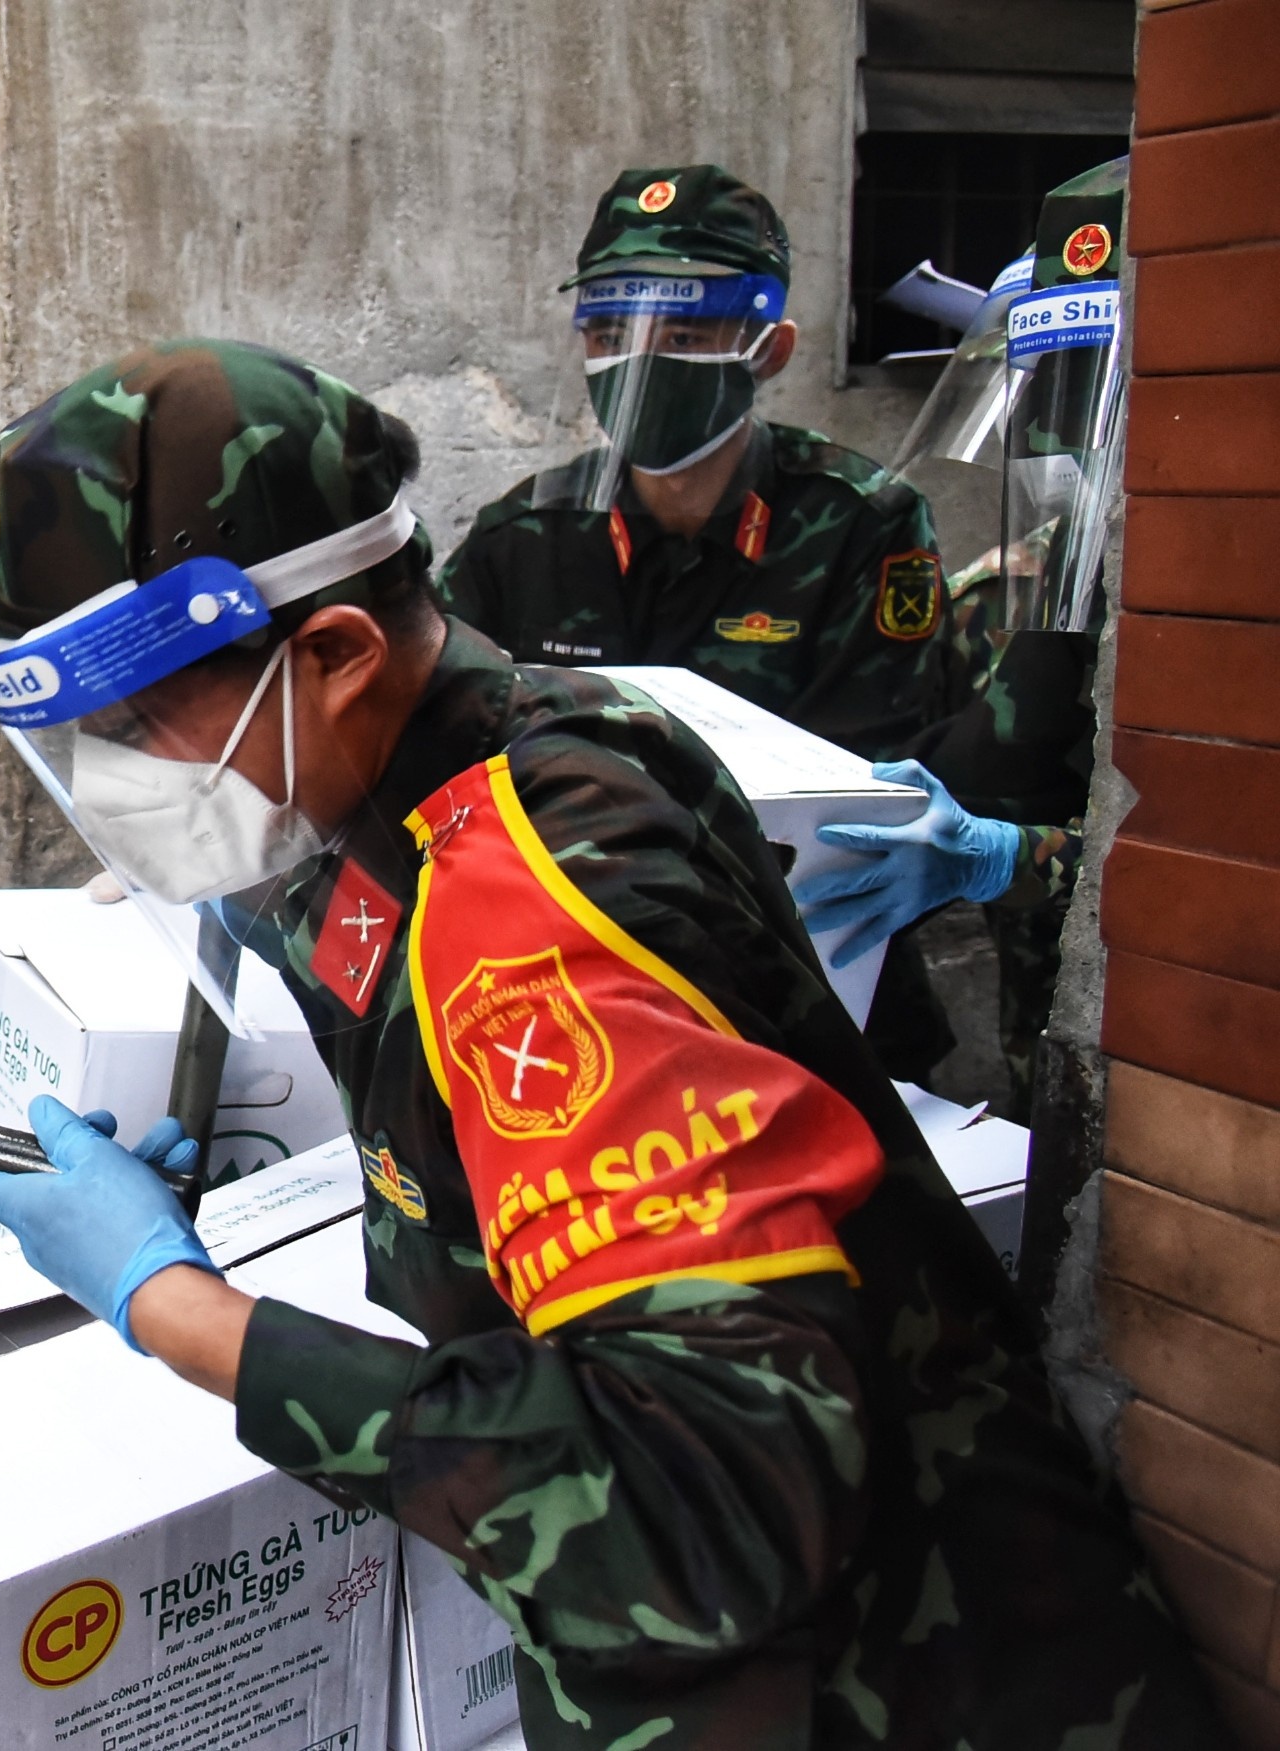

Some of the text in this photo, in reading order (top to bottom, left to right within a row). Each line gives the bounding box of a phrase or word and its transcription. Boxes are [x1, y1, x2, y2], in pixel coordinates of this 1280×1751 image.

[585, 281, 694, 299] Face Shield
[1012, 298, 1119, 333] Face Shi
[1013, 331, 1112, 351] Protective Isolation
[2, 1043, 28, 1083] Eggs
[13, 1027, 30, 1059] GÀ
[33, 1045, 62, 1089] TƯƠI
[589, 1086, 760, 1193] SOÁT
[140, 1550, 251, 1617] TRỨNG
[260, 1522, 303, 1566] GÀ
[158, 1559, 306, 1641] Fresh Eggs
[35, 1602, 109, 1664] CP
[111, 1682, 140, 1702] CÔNG
[141, 1676, 155, 1689] TY
[201, 1643, 228, 1663] CHĂN
[229, 1634, 253, 1650] NUÔI
[253, 1626, 267, 1639] CP
[267, 1615, 288, 1632] VIỆT
[289, 1606, 310, 1622] NAM
[167, 1679, 184, 1693] KCN
[251, 1643, 264, 1655] Nai
[274, 1697, 295, 1713] VIỆT
